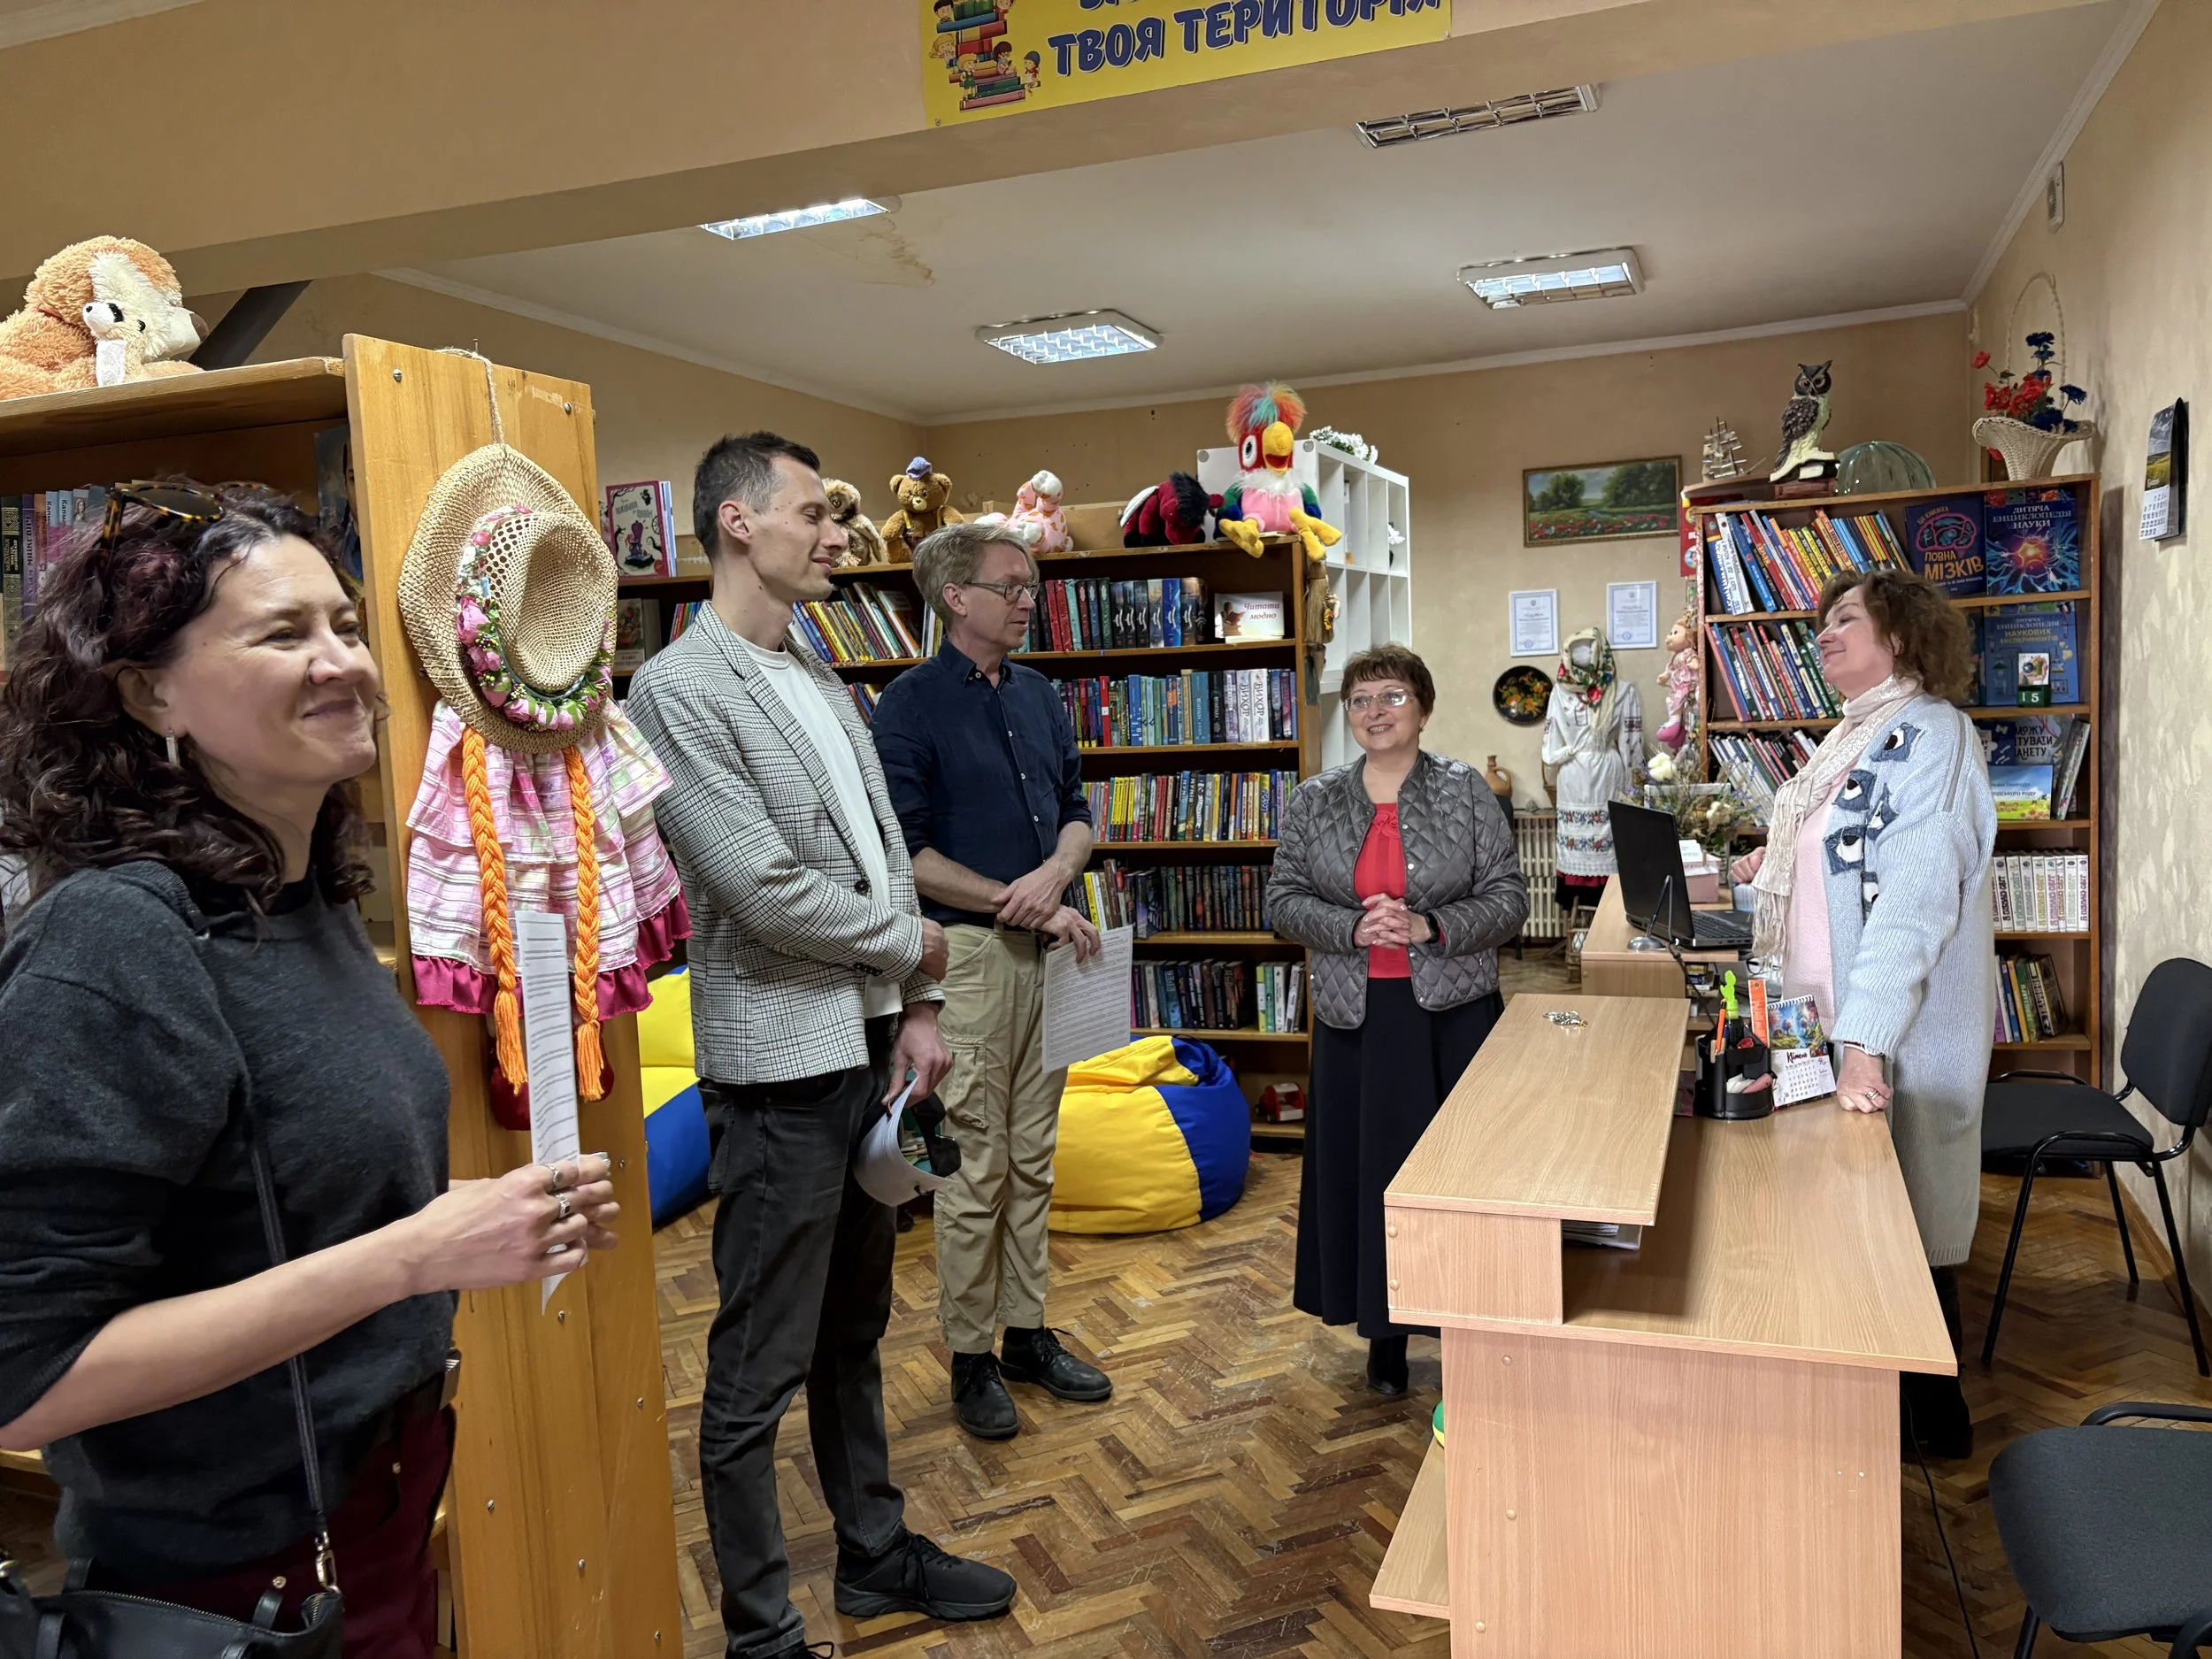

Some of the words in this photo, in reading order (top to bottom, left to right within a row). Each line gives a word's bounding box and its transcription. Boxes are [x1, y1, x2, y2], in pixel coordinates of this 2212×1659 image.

[1048, 17, 1165, 76] ТВОЯ
[2013, 505, 2050, 514] ДИТЯЧА
[1993, 511, 2071, 523] ЕНЦИКЛОПЕДІЯ
[2013, 519, 2051, 529] НАУКИ
[1924, 550, 1956, 562] ПОВНА
[1924, 556, 1984, 580] МІЗКІВ
[2004, 627, 2052, 638] НАУКОВИХ
[1240, 682, 1250, 717] ВИХОР
[1254, 680, 1264, 716] ВИХОР
